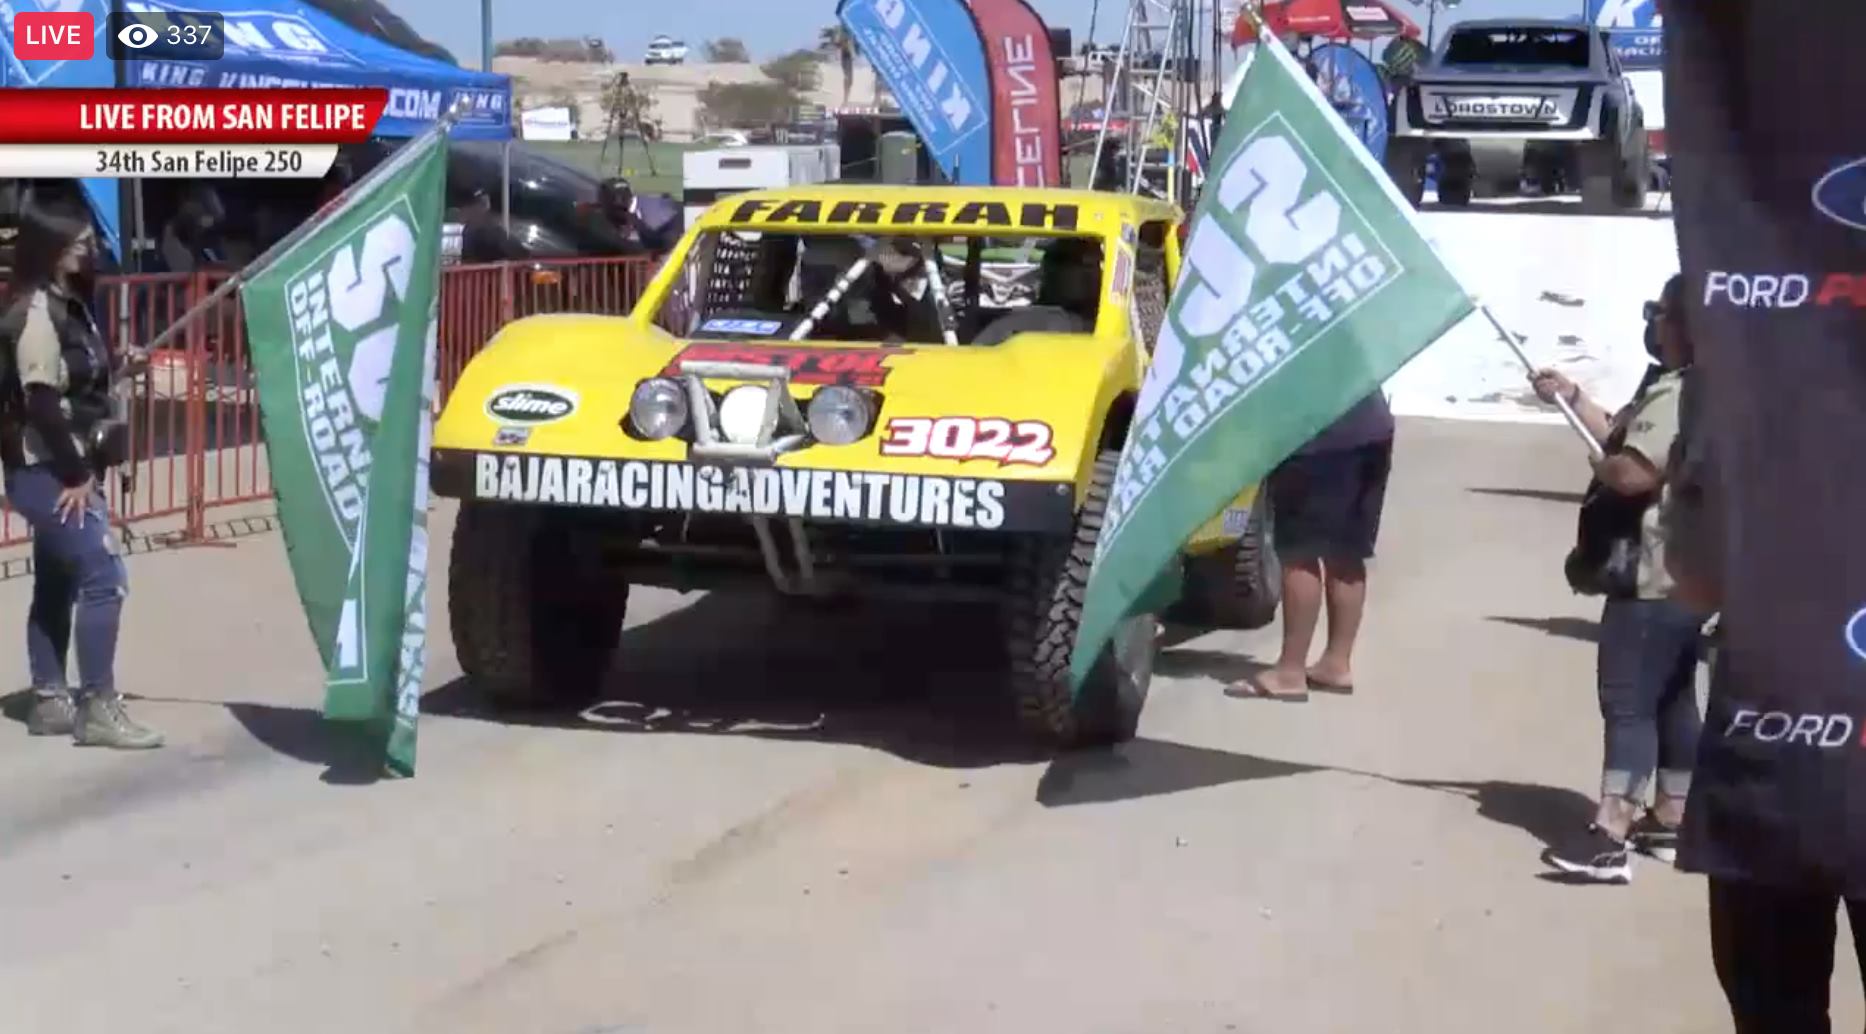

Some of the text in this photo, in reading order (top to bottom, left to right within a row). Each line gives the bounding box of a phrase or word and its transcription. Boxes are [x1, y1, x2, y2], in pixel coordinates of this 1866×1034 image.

[141, 62, 204, 86] KING
[1434, 101, 1557, 116] LORDSTOWN
[730, 200, 1079, 231] FARRAH
[1704, 271, 1809, 308] FORD
[493, 393, 568, 415] slime
[880, 416, 1056, 467] 3022
[475, 453, 1006, 530] BAJARACINGADVENTURES
[1724, 709, 1853, 747] FORD
